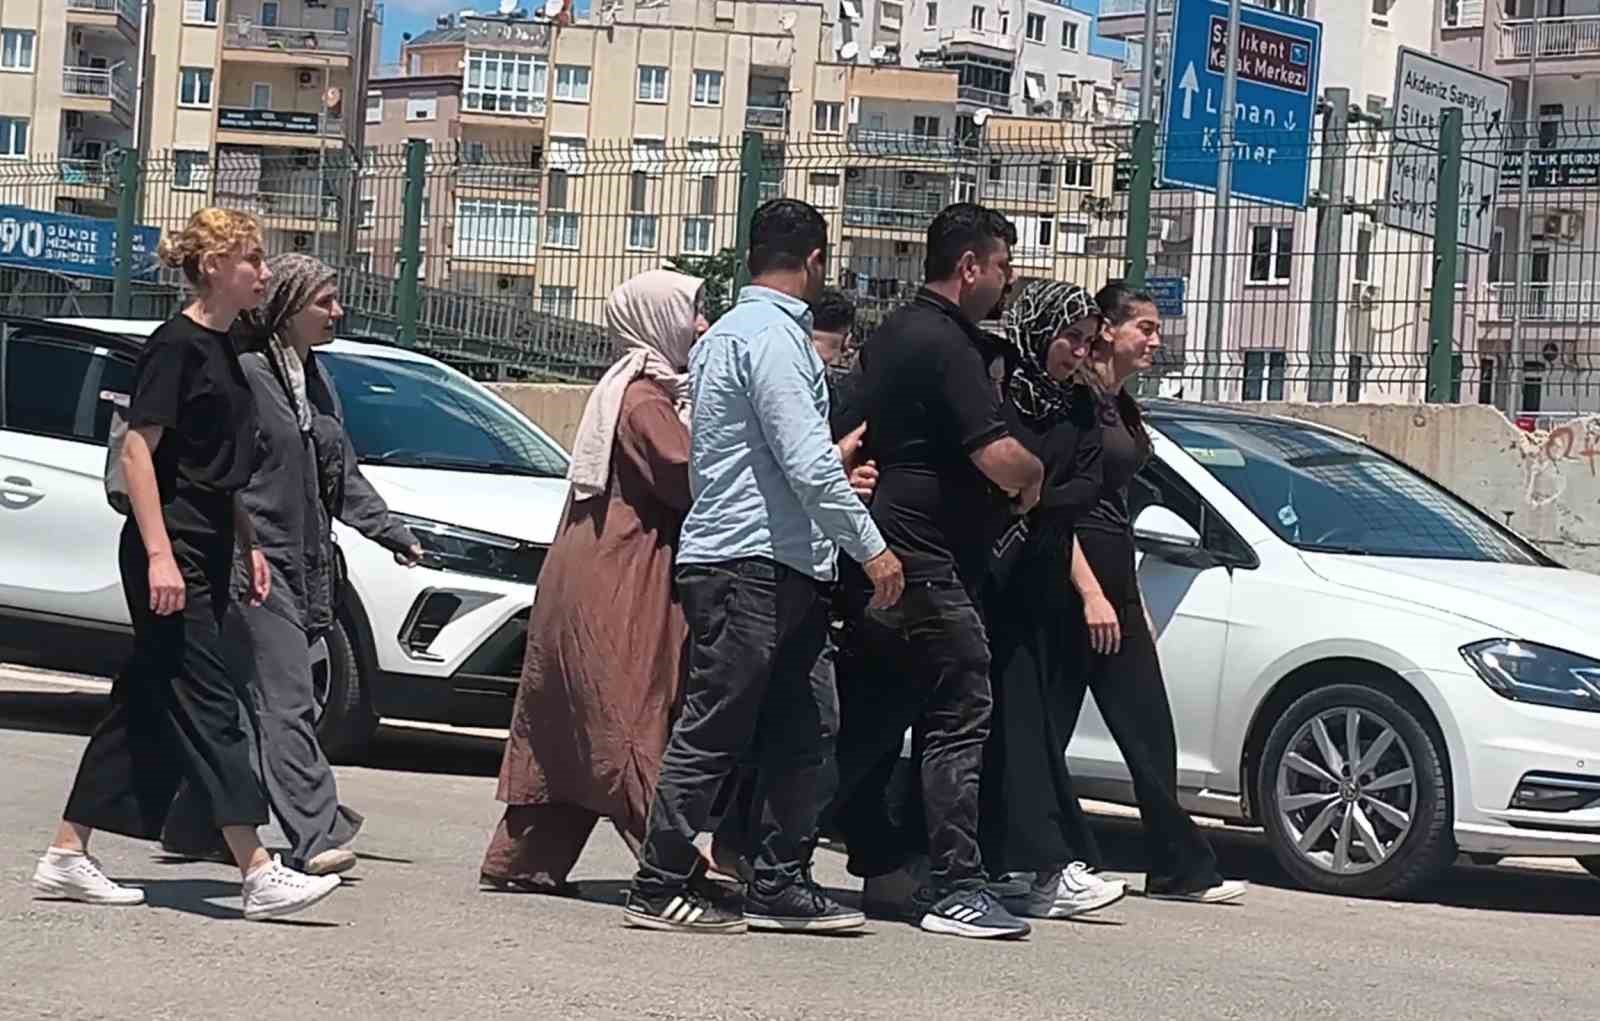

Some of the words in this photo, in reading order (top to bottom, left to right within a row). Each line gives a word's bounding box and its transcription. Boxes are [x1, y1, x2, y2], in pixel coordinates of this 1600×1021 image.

[1212, 24, 1285, 59] Salıkent
[1210, 46, 1251, 75] Kaak
[1254, 57, 1307, 87] Merkezi
[1404, 70, 1447, 100] Akdeniz
[1205, 88, 1276, 128] Lman
[0, 217, 45, 257] 90
